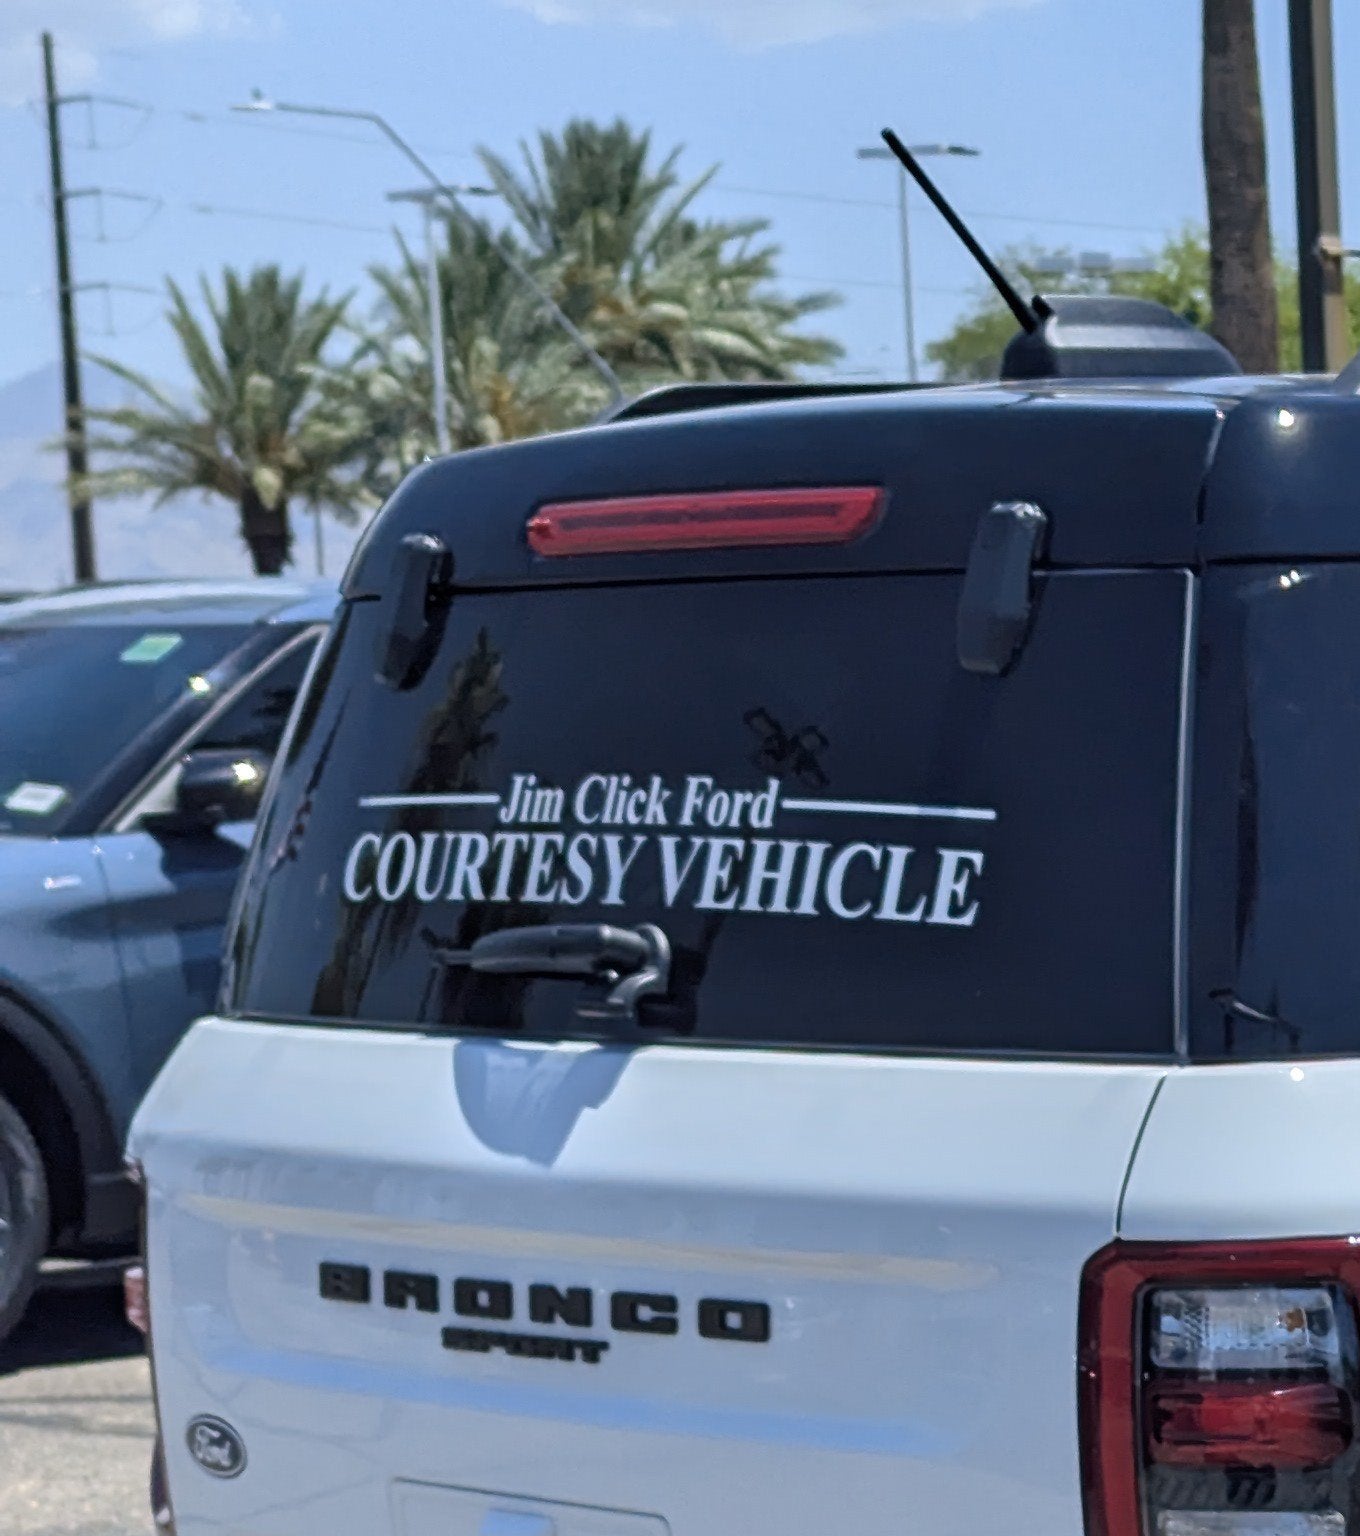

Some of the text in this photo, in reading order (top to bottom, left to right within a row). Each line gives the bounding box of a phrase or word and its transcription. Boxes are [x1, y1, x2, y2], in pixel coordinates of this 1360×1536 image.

[501, 774, 780, 829] Jim Click Ford
[344, 831, 985, 927] COURTESY VEHICLE
[318, 1260, 772, 1342] BRONCO
